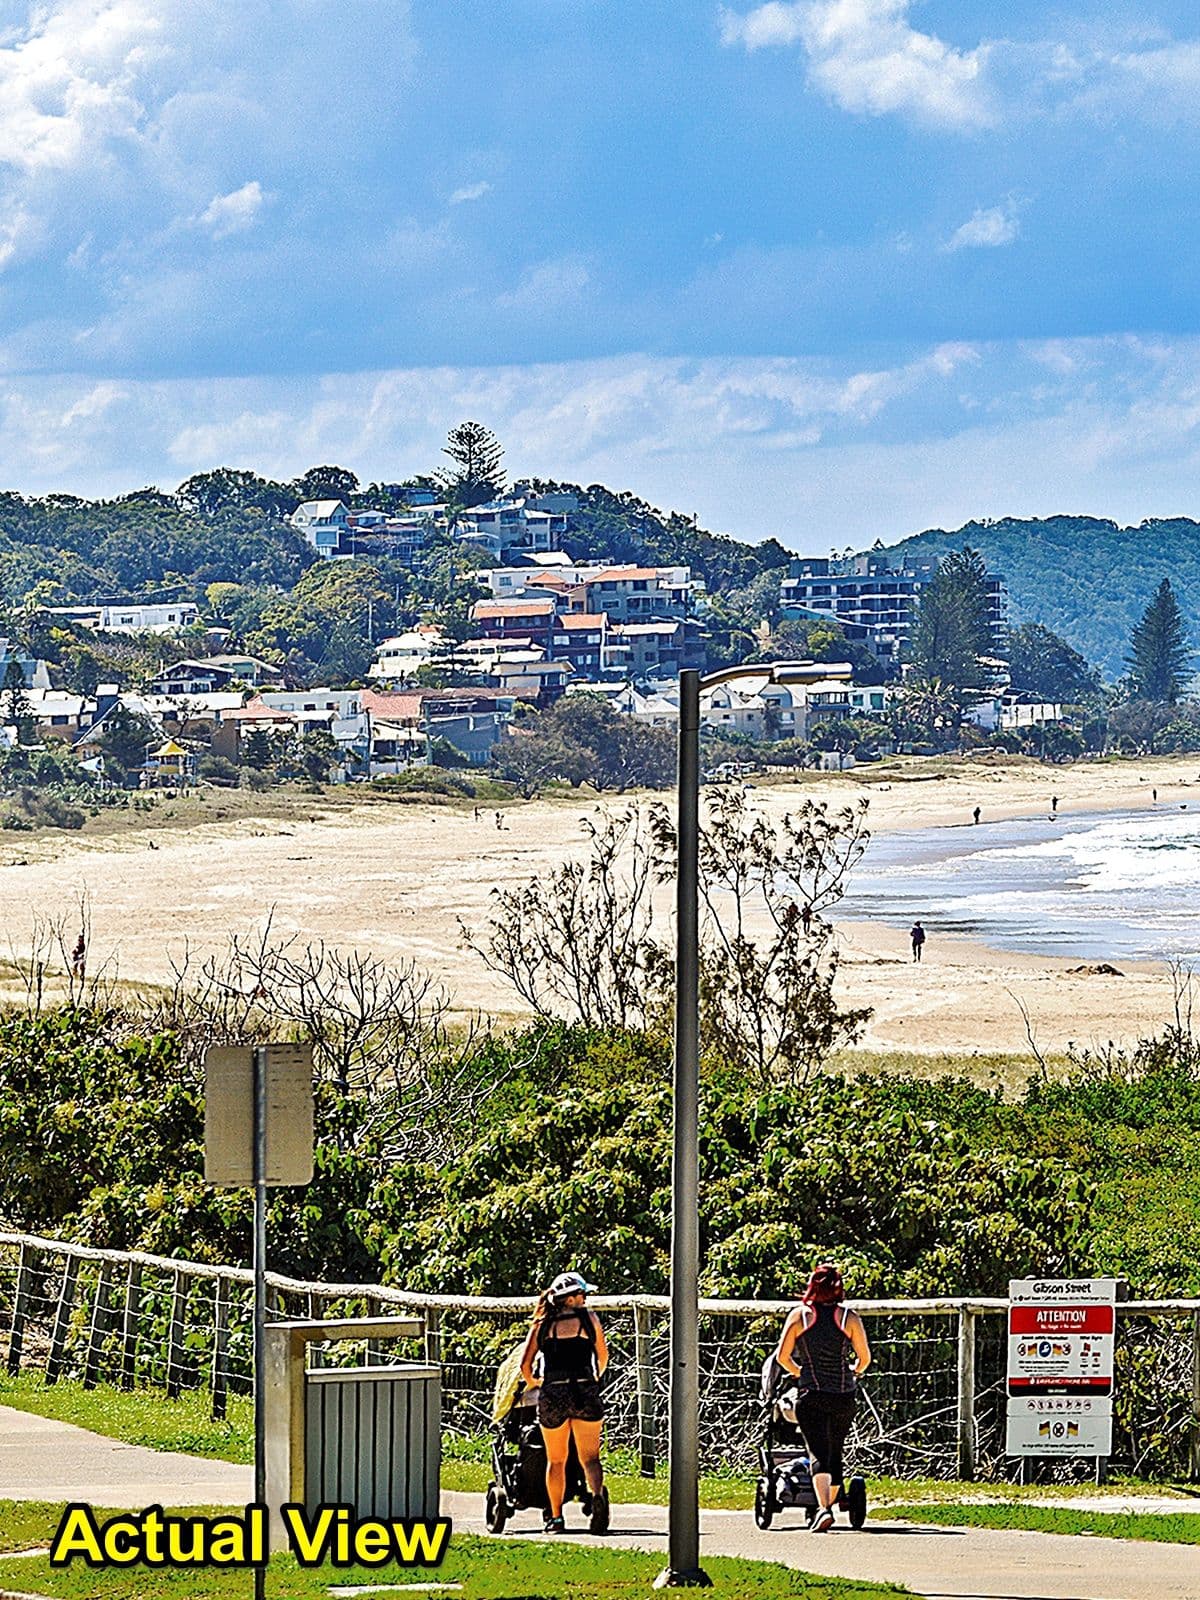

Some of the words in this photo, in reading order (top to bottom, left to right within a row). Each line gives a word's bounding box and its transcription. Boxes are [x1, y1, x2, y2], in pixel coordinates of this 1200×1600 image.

[1032, 1282, 1064, 1294] Gibson
[1065, 1282, 1092, 1294] Street
[1036, 1310, 1086, 1323] ATTENTION
